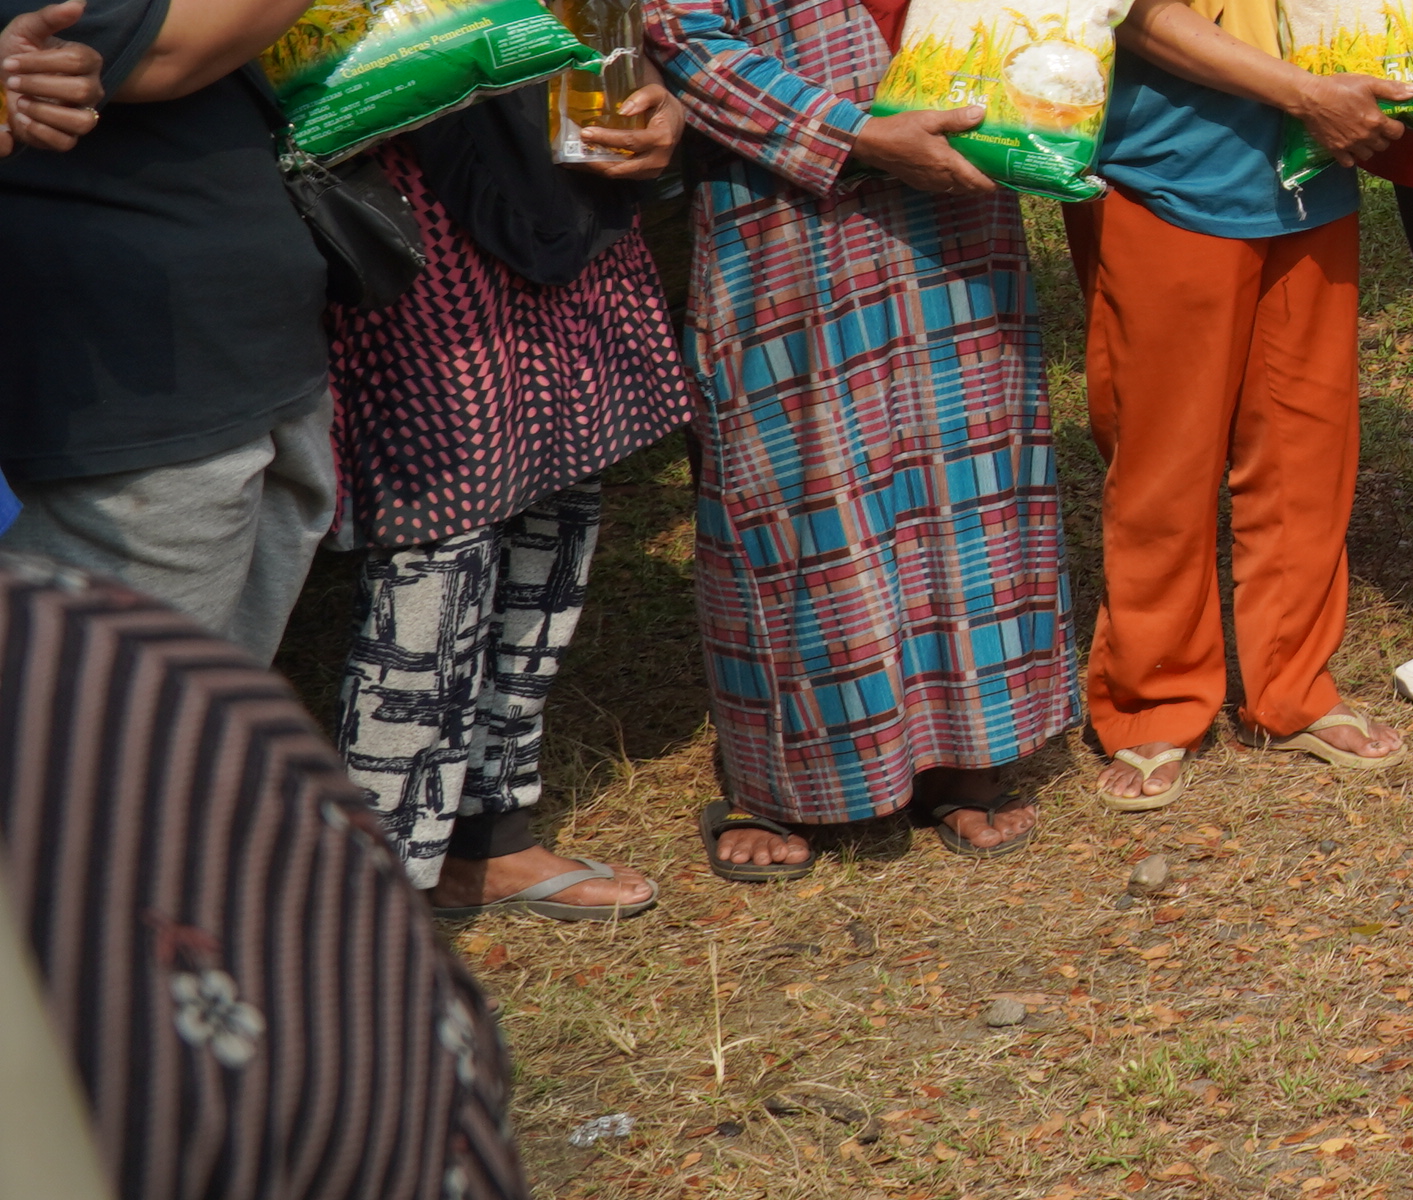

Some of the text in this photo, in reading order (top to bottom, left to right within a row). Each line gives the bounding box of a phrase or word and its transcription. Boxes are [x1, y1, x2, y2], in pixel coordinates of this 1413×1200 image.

[341, 53, 398, 80] Cadangan
[398, 37, 432, 58] Beras
[430, 17, 494, 47] Pemerintah
[1386, 62, 1402, 81] 5
[948, 80, 990, 110] 5 kg
[969, 131, 1021, 148] Pemerintah
